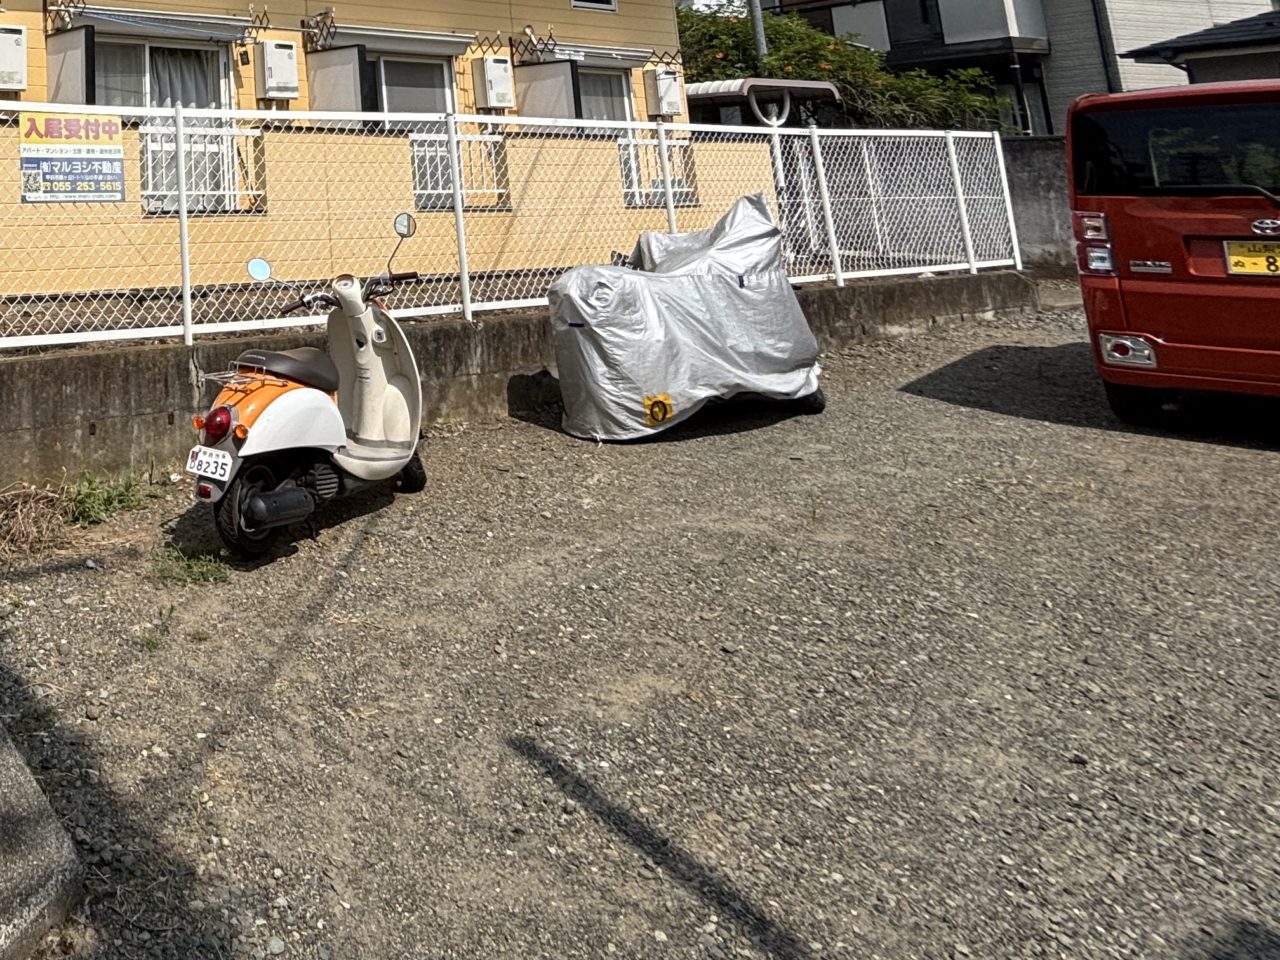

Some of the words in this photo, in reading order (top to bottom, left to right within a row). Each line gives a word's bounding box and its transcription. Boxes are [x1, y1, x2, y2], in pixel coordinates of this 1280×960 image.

[24, 117, 120, 141] 入居受付中
